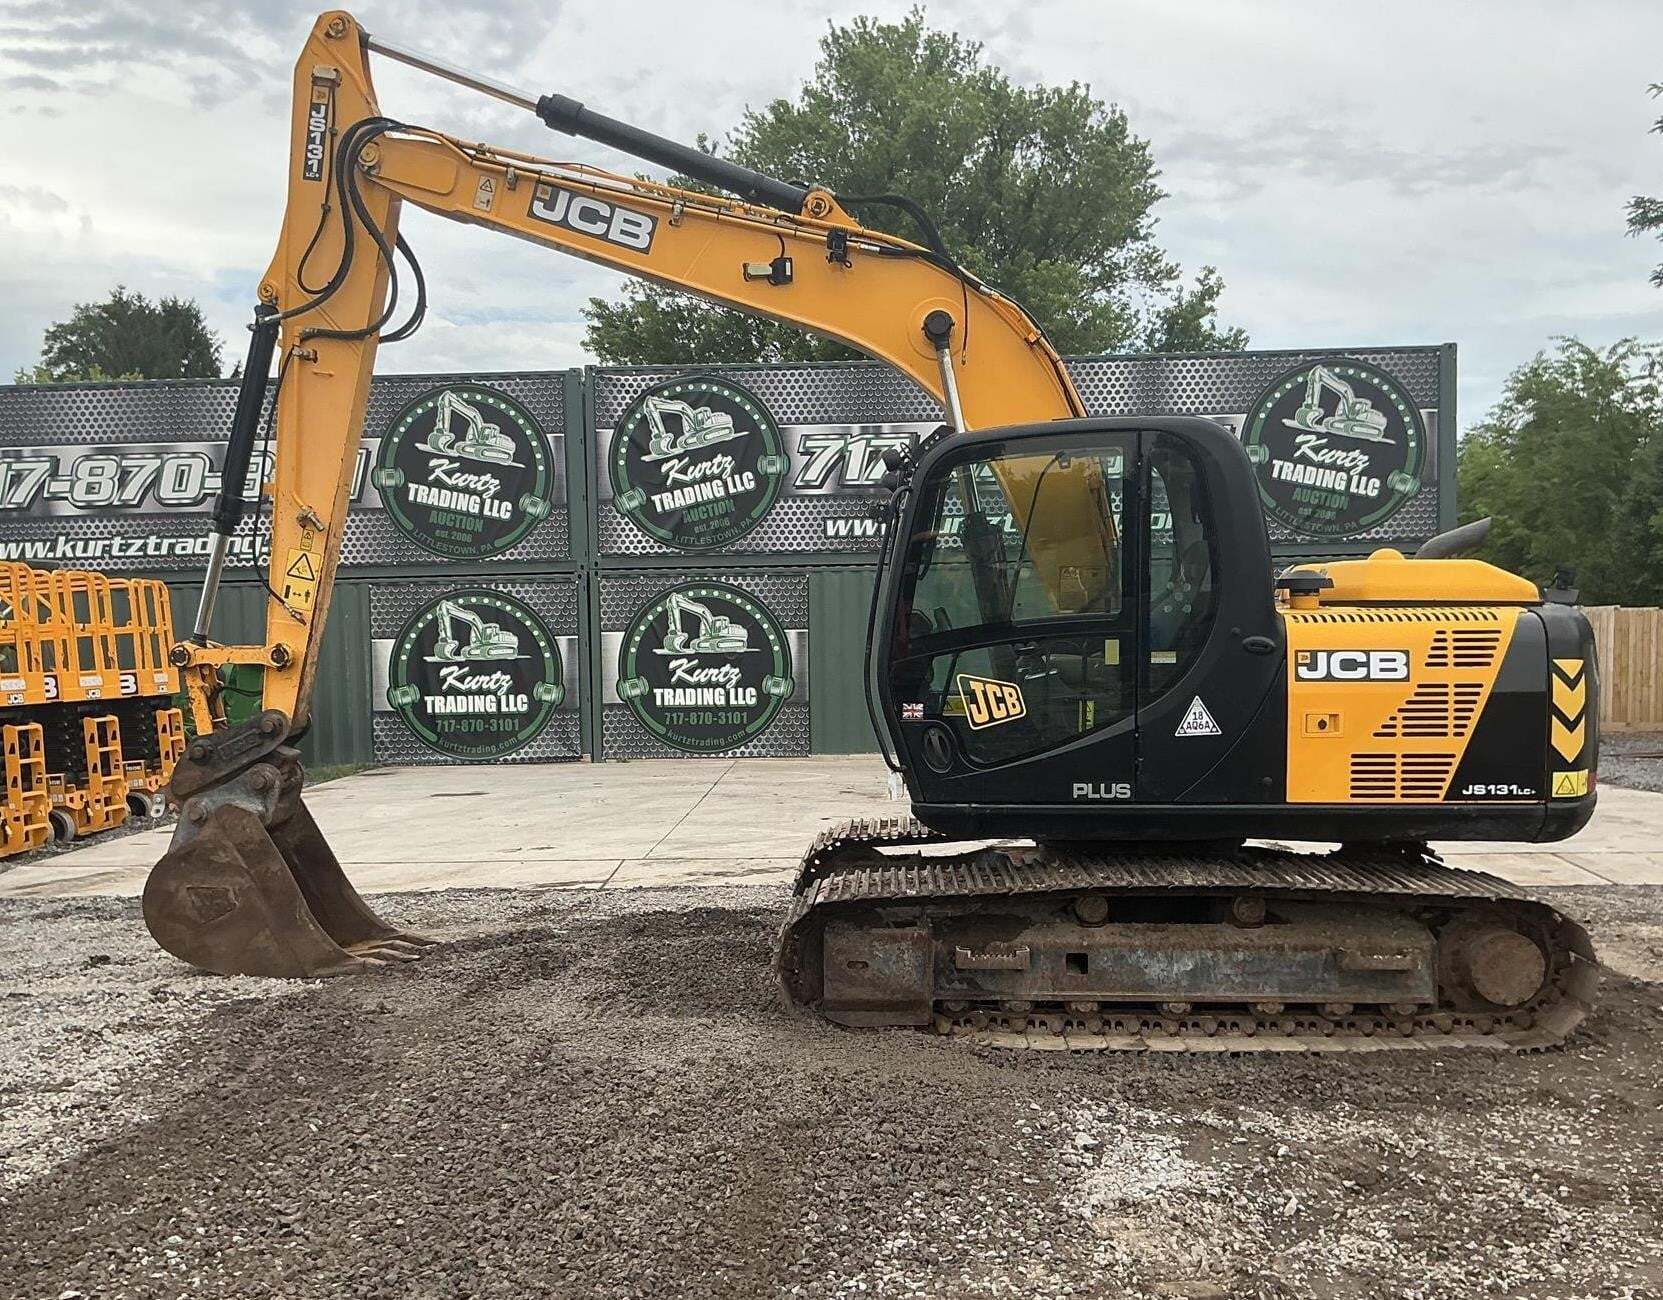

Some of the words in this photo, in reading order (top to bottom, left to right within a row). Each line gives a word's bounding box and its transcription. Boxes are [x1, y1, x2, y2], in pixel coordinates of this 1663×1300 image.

[533, 190, 653, 249] JCB
[1293, 434, 1370, 474] Kurtz
[428, 458, 501, 499] Kurtz
[661, 453, 735, 487] Kurtz
[1272, 459, 1348, 491] TRADING
[1350, 475, 1381, 497] LLC
[408, 483, 480, 514] TRADING
[483, 498, 513, 520] LLC
[651, 478, 724, 513] TRADING
[726, 471, 755, 494] LLC
[1292, 488, 1349, 510] AUCTION
[429, 512, 484, 533] AUCTION
[683, 499, 735, 524] AUCTION
[669, 658, 742, 689] Kurtz
[1298, 651, 1408, 680] JCB
[439, 665, 513, 695] Kurtz
[424, 695, 497, 714] TRADING
[500, 694, 528, 713] LLC
[653, 688, 725, 706] TRADING
[729, 687, 757, 705] LLC
[969, 680, 1021, 724] JCB
[436, 718, 519, 733] 717-870-3101
[664, 711, 748, 725] 717-870-3101
[1186, 721, 1211, 731] AQ6A
[1192, 711, 1204, 721] 18
[667, 729, 746, 746] kurtztrading.com
[1073, 783, 1131, 799] PLUS
